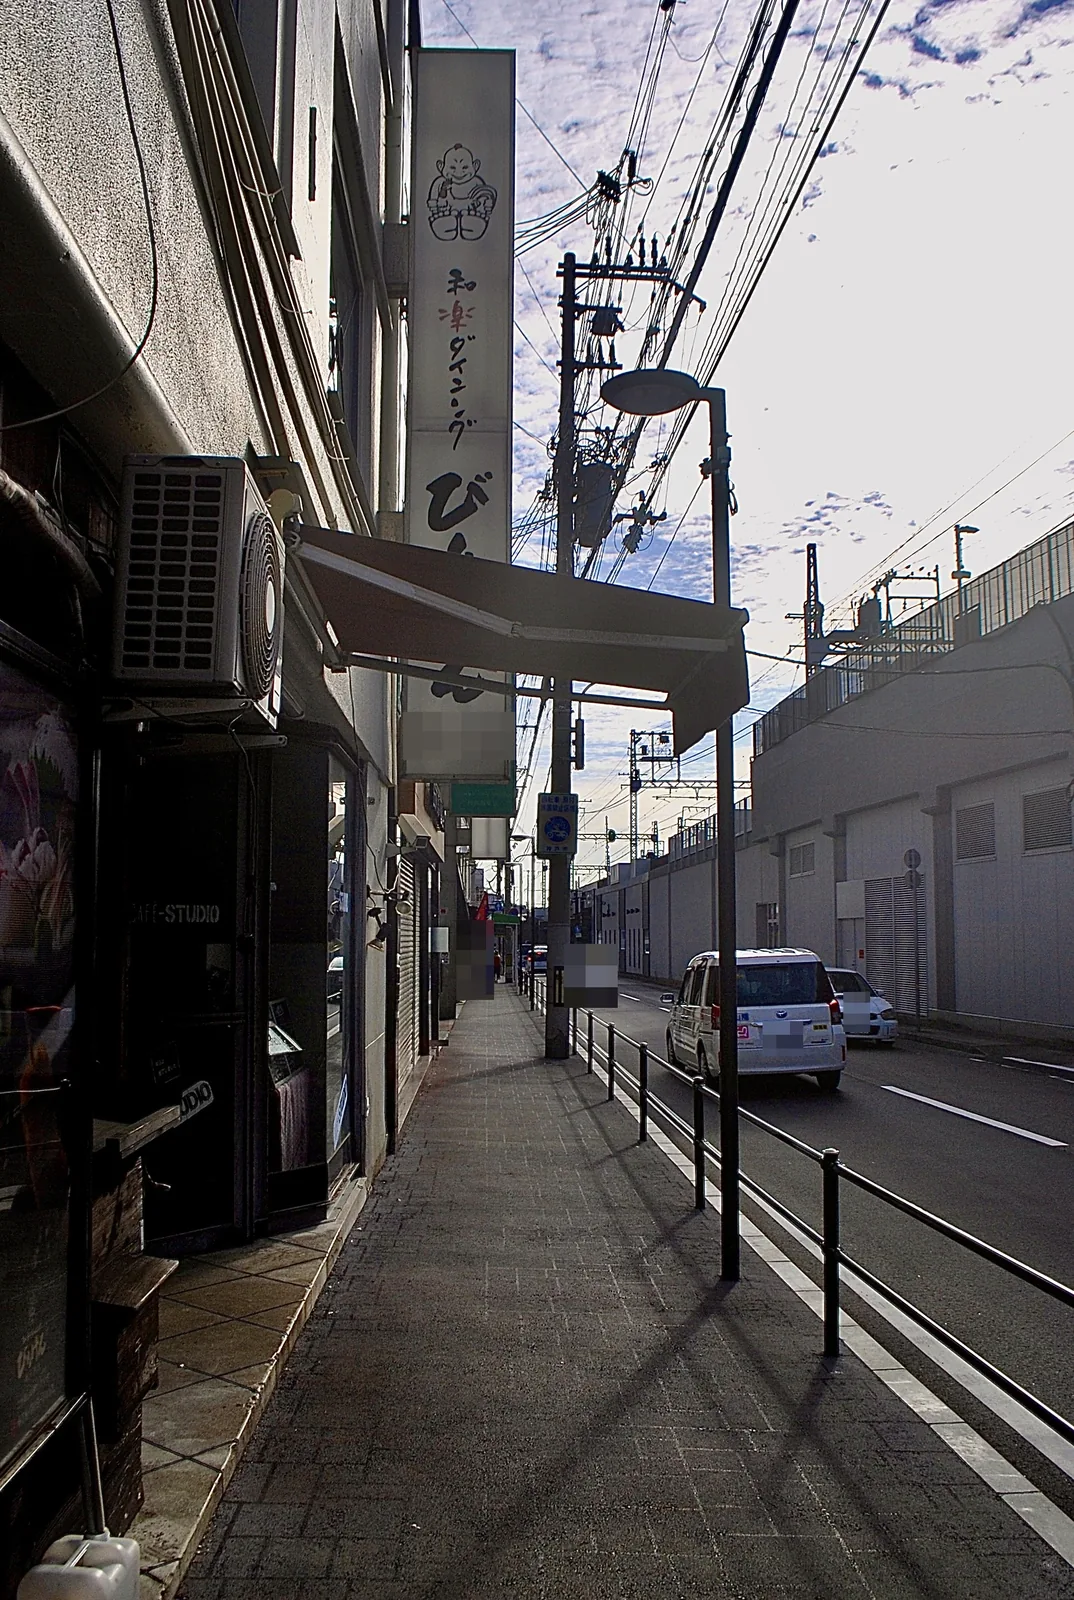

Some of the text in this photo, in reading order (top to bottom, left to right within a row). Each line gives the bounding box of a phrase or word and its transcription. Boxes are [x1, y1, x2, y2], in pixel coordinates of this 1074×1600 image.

[438, 268, 477, 451] 和楽ダイニング
